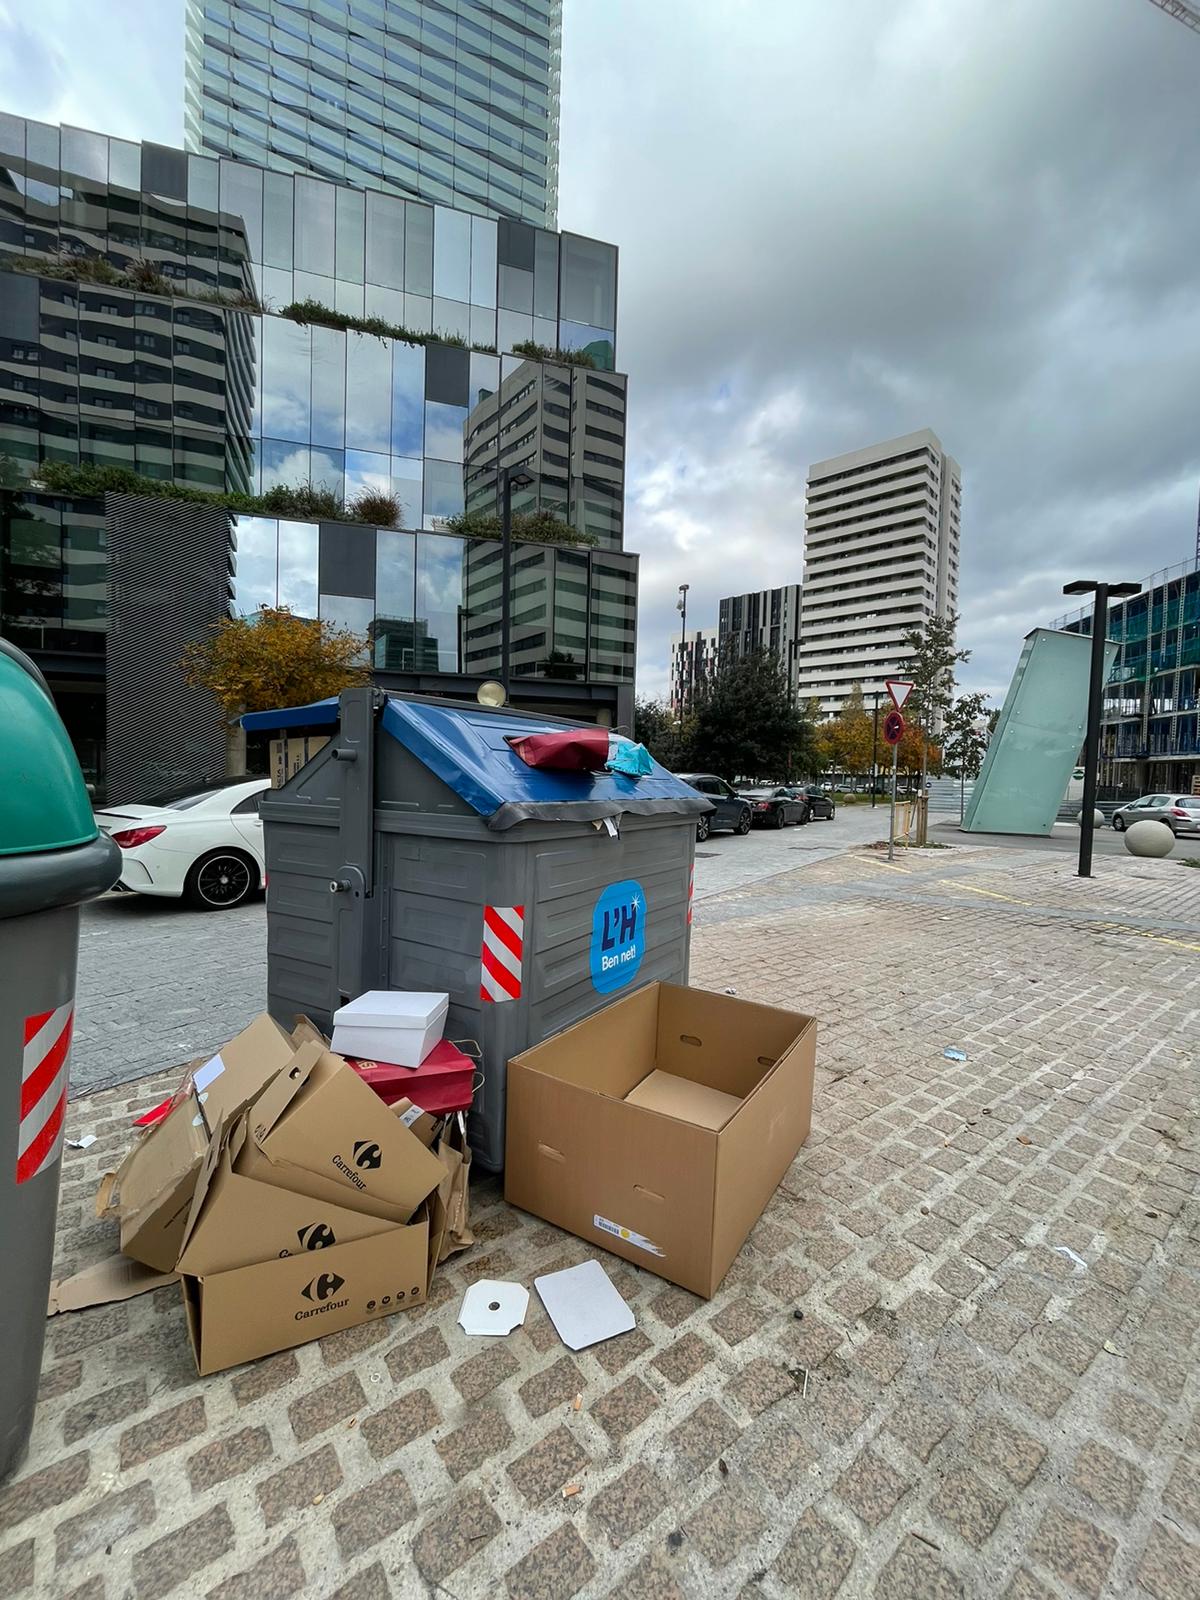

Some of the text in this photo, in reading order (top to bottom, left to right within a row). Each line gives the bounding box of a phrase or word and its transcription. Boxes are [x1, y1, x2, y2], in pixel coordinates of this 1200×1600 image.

[601, 944, 636, 971] Ben net!
[332, 1154, 367, 1190] Carrefour
[294, 1298, 350, 1321] Carrefour
